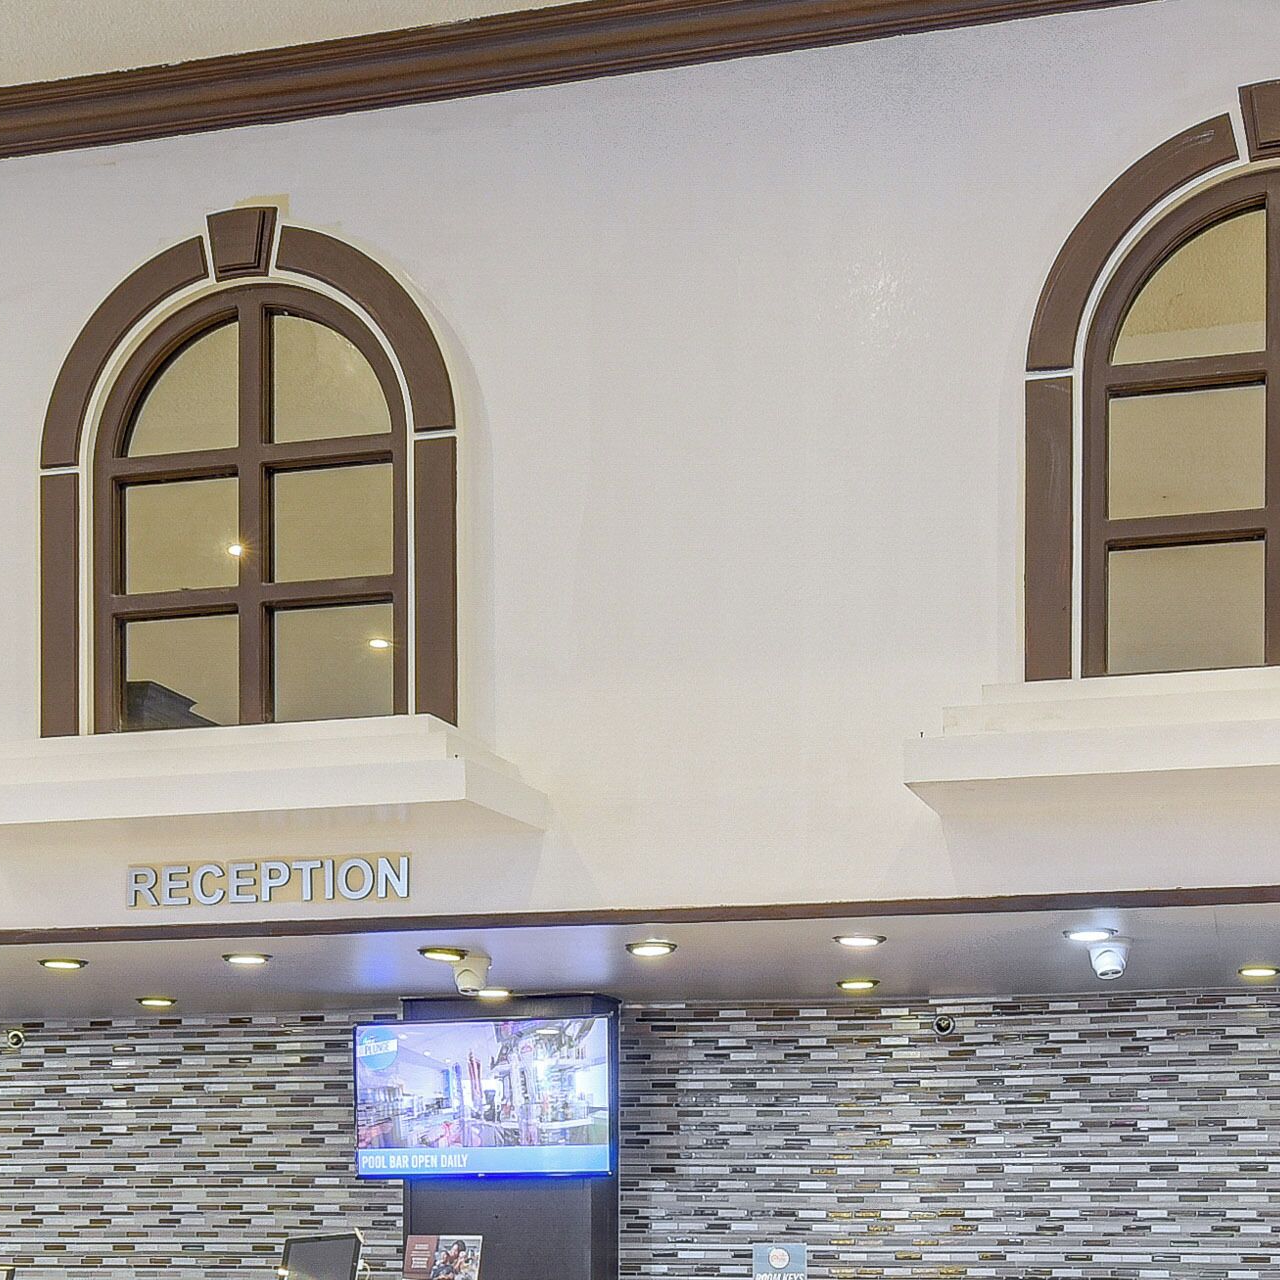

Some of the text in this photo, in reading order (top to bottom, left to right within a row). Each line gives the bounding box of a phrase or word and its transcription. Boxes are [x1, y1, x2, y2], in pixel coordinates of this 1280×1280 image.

[128, 856, 410, 906] RECEPTION
[362, 1153, 468, 1169] POOL BAR OPEN DAILY
